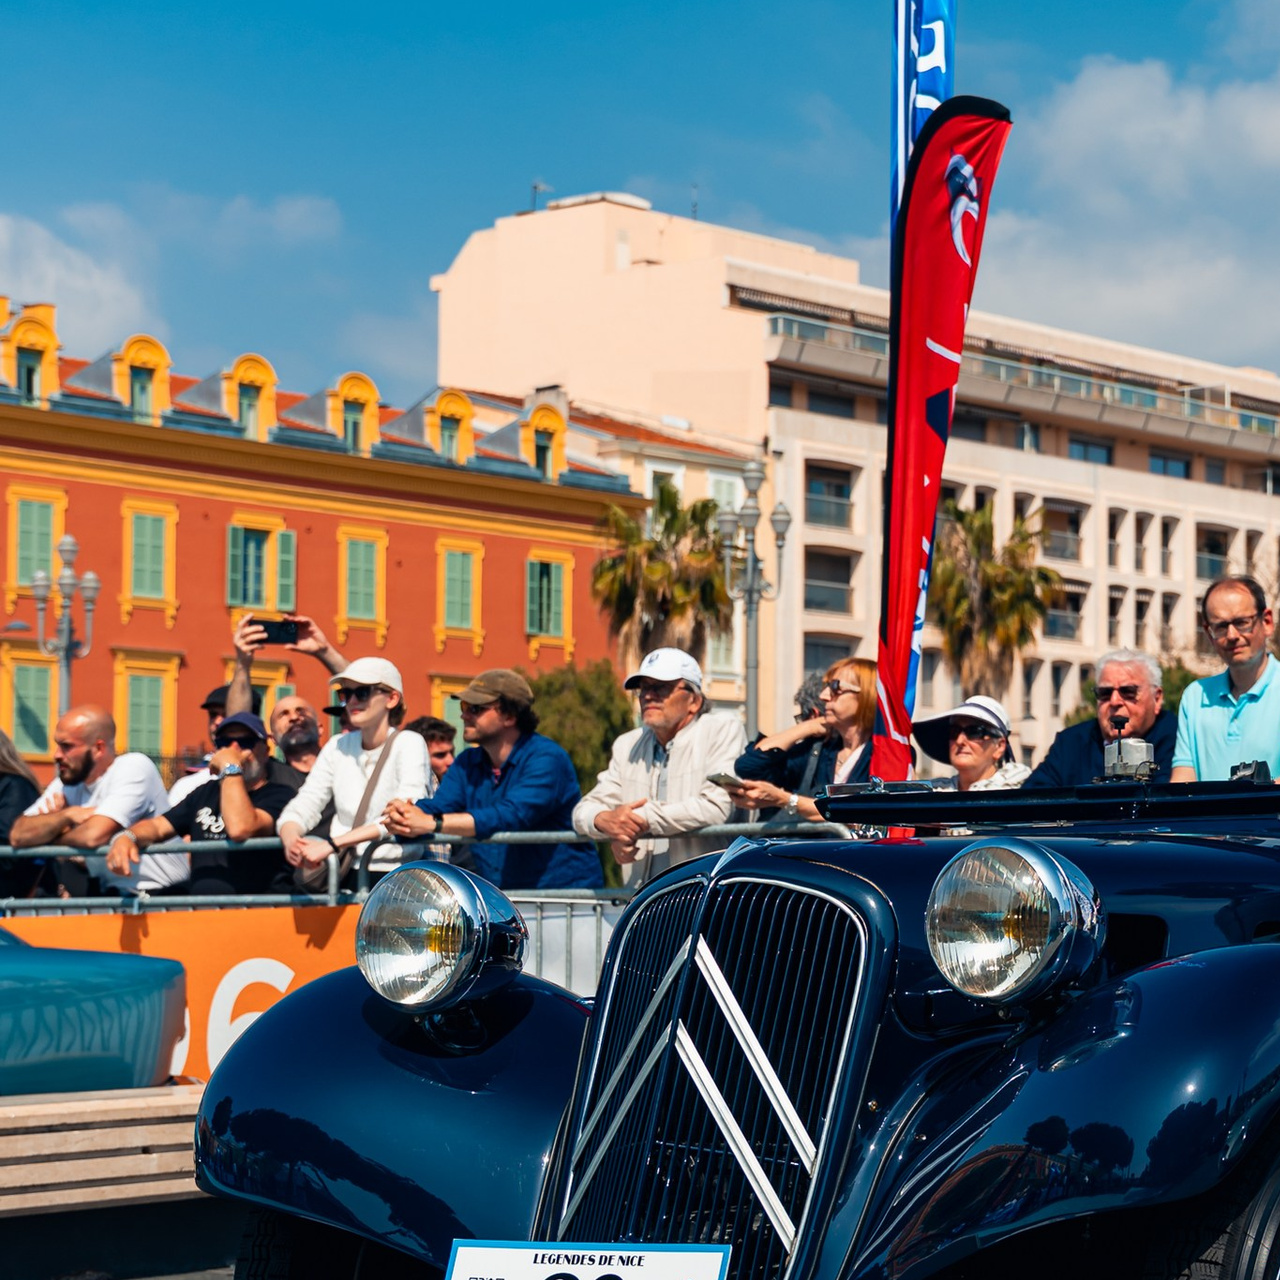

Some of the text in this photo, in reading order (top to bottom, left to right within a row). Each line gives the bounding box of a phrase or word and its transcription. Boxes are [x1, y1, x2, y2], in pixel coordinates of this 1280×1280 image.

[533, 1253, 646, 1267] LEGENDES DE NICE
